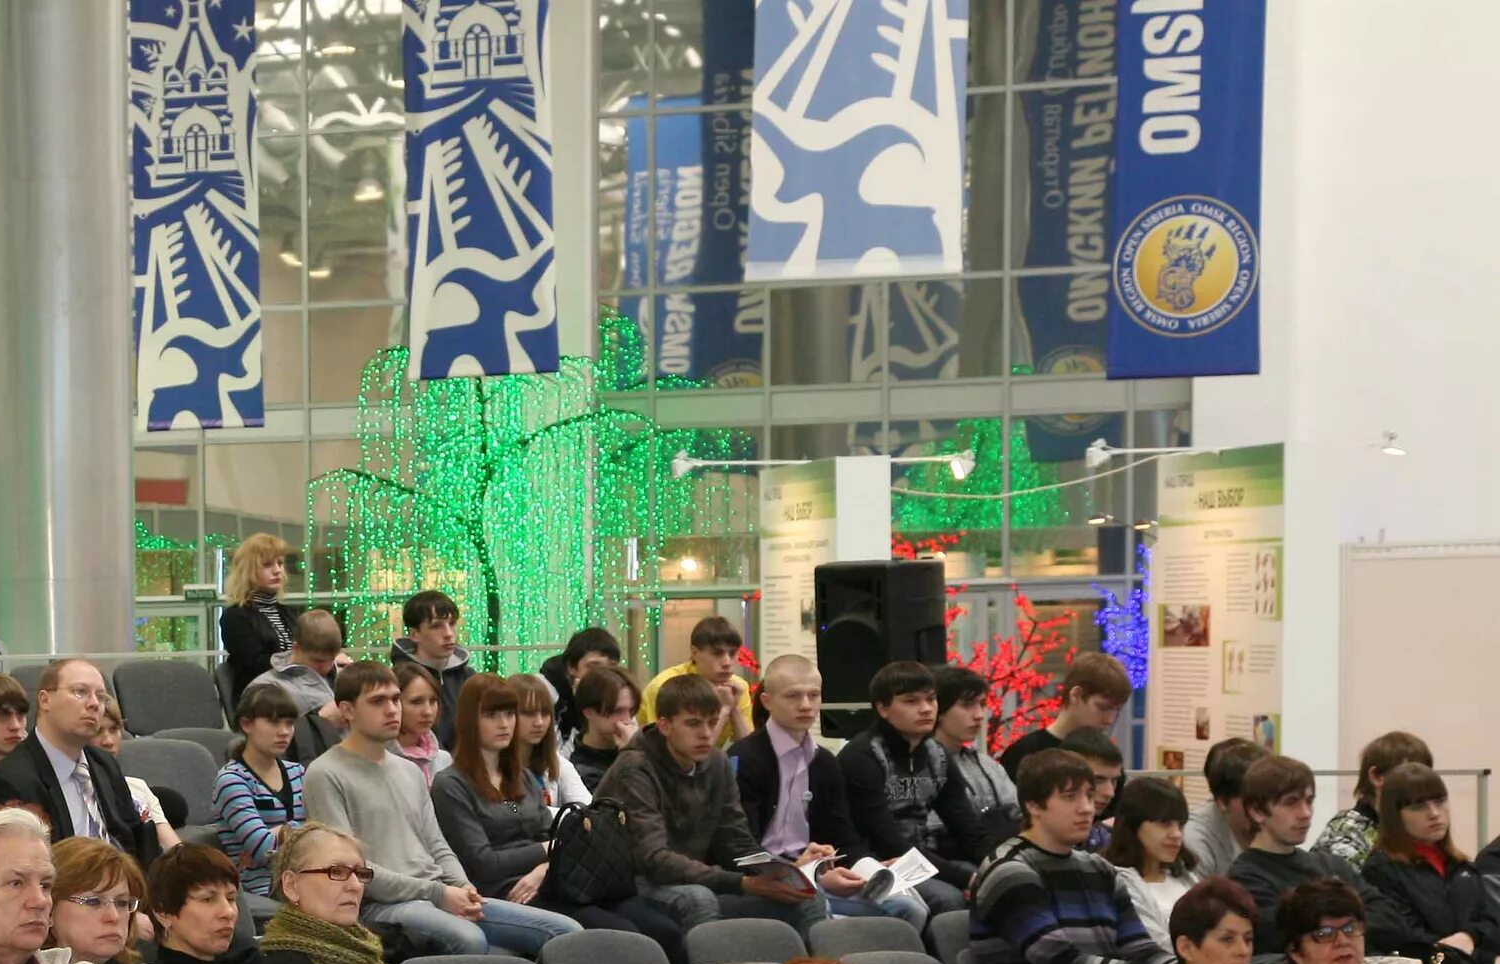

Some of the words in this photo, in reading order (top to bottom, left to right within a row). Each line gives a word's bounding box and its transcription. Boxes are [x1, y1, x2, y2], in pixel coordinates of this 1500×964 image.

[1122, 230, 1144, 262] OPEN
[1140, 203, 1185, 230] SIBERIA
[1190, 202, 1229, 223] OMSK
[1225, 218, 1252, 264] REGION
[1121, 267, 1145, 309] REGION
[1228, 269, 1251, 302] OPEN
[1143, 308, 1179, 329] OMSK
[1187, 302, 1233, 329] SIBERIA
